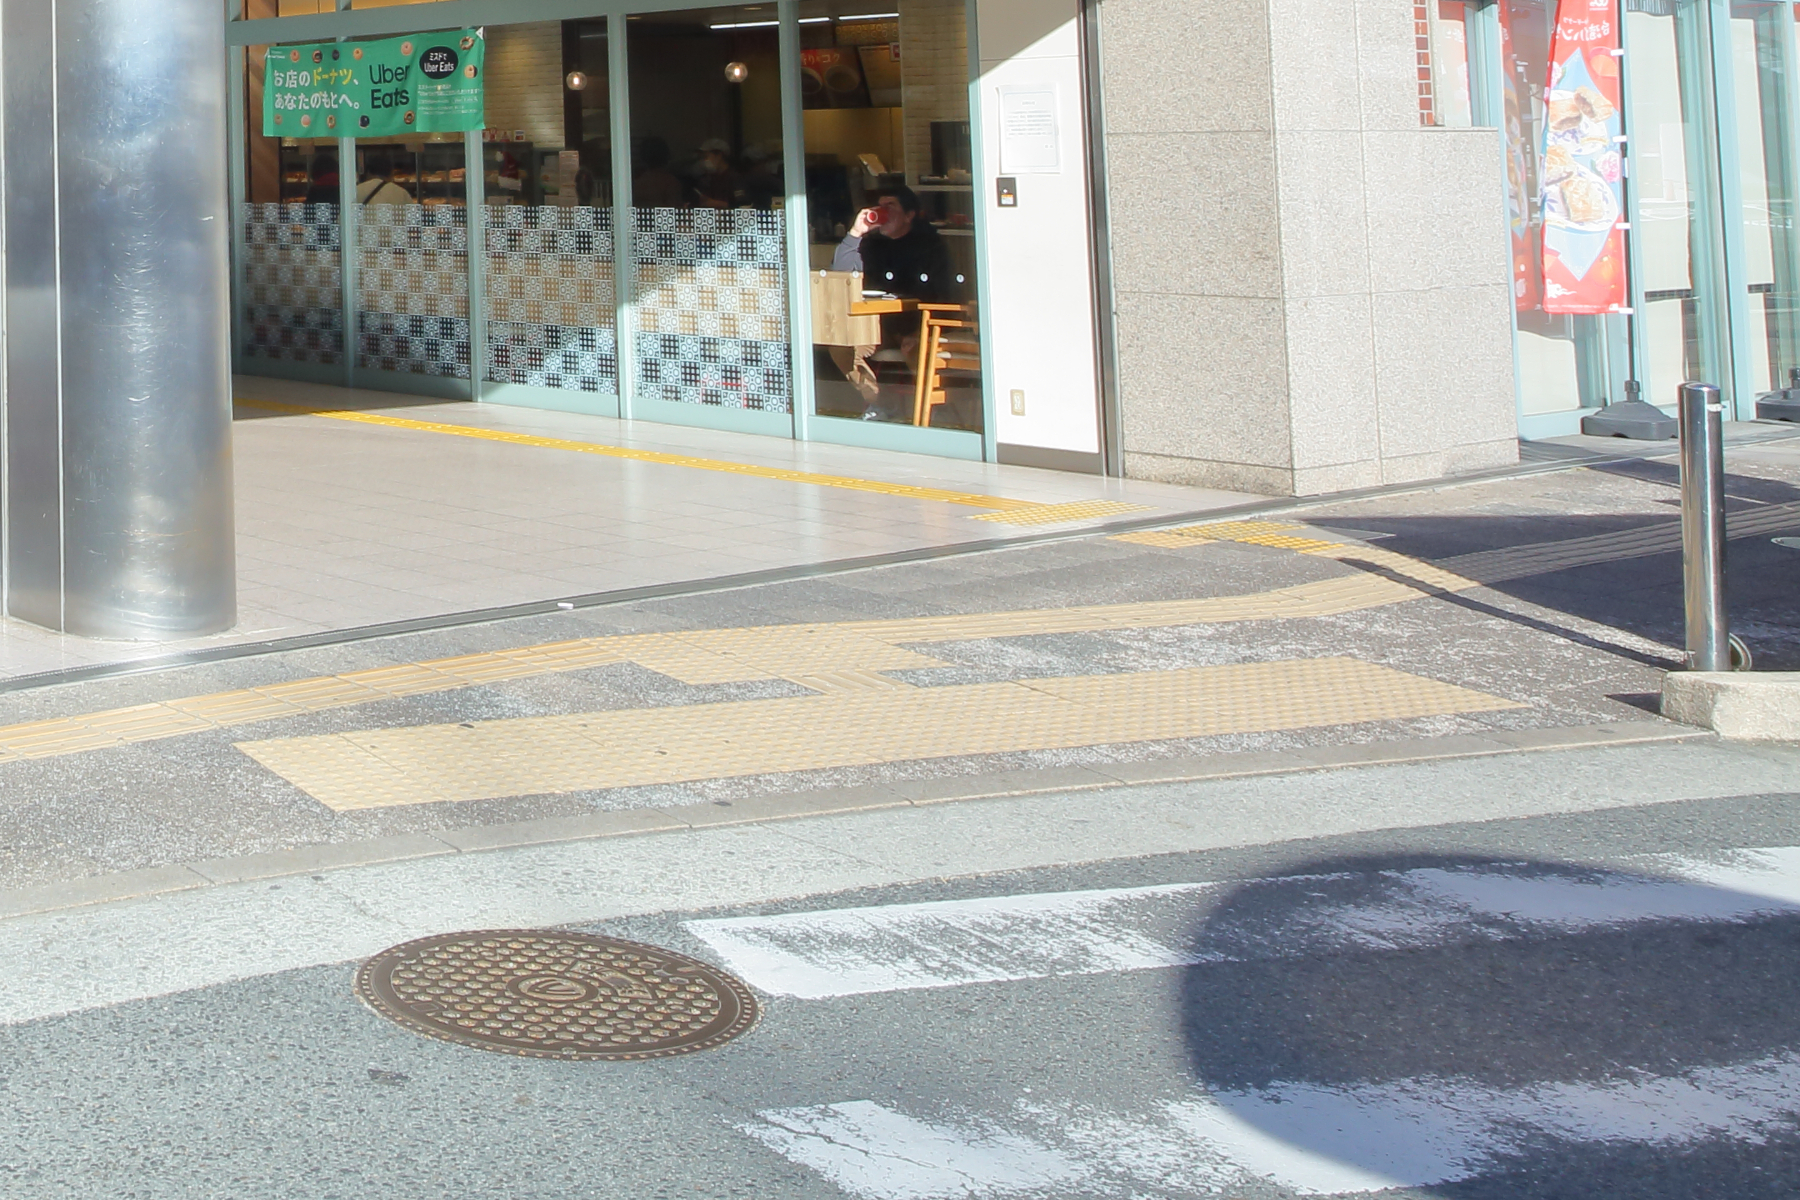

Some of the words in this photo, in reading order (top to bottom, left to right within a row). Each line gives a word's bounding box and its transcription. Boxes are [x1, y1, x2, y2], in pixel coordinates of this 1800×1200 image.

[274, 66, 359, 89] お店のドーナツ、
[369, 63, 410, 85] Uber
[424, 63, 439, 73] Uber
[439, 61, 455, 72] Eats
[274, 91, 360, 111] あなたのもとへ。
[370, 87, 411, 109] Eats
